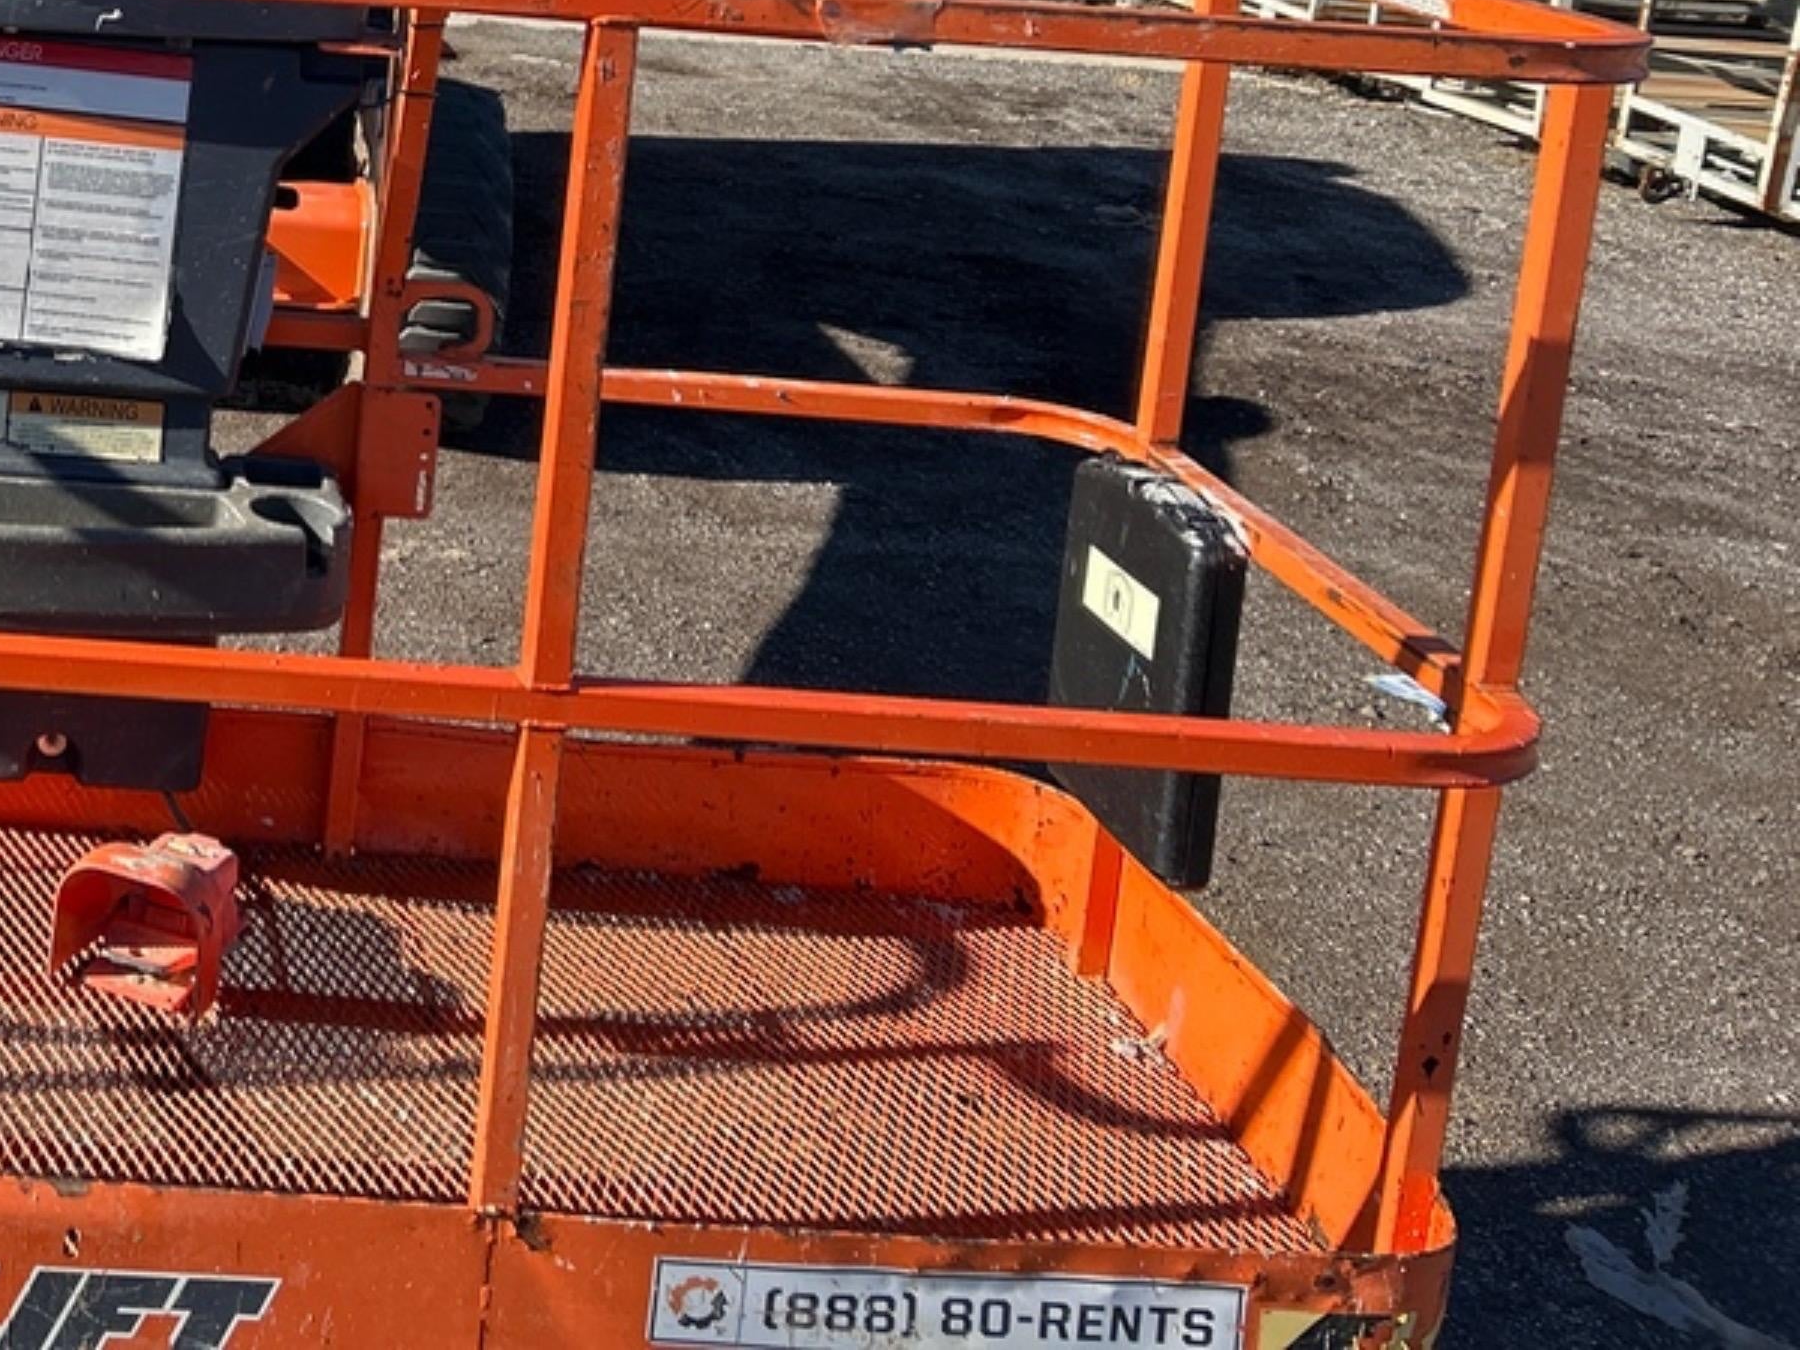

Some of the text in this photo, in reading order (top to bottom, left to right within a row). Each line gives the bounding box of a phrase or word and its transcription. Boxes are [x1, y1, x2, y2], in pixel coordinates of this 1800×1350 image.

[50, 396, 139, 420] WARNING
[762, 1288, 1217, 1349] (888) 80-RENTS
